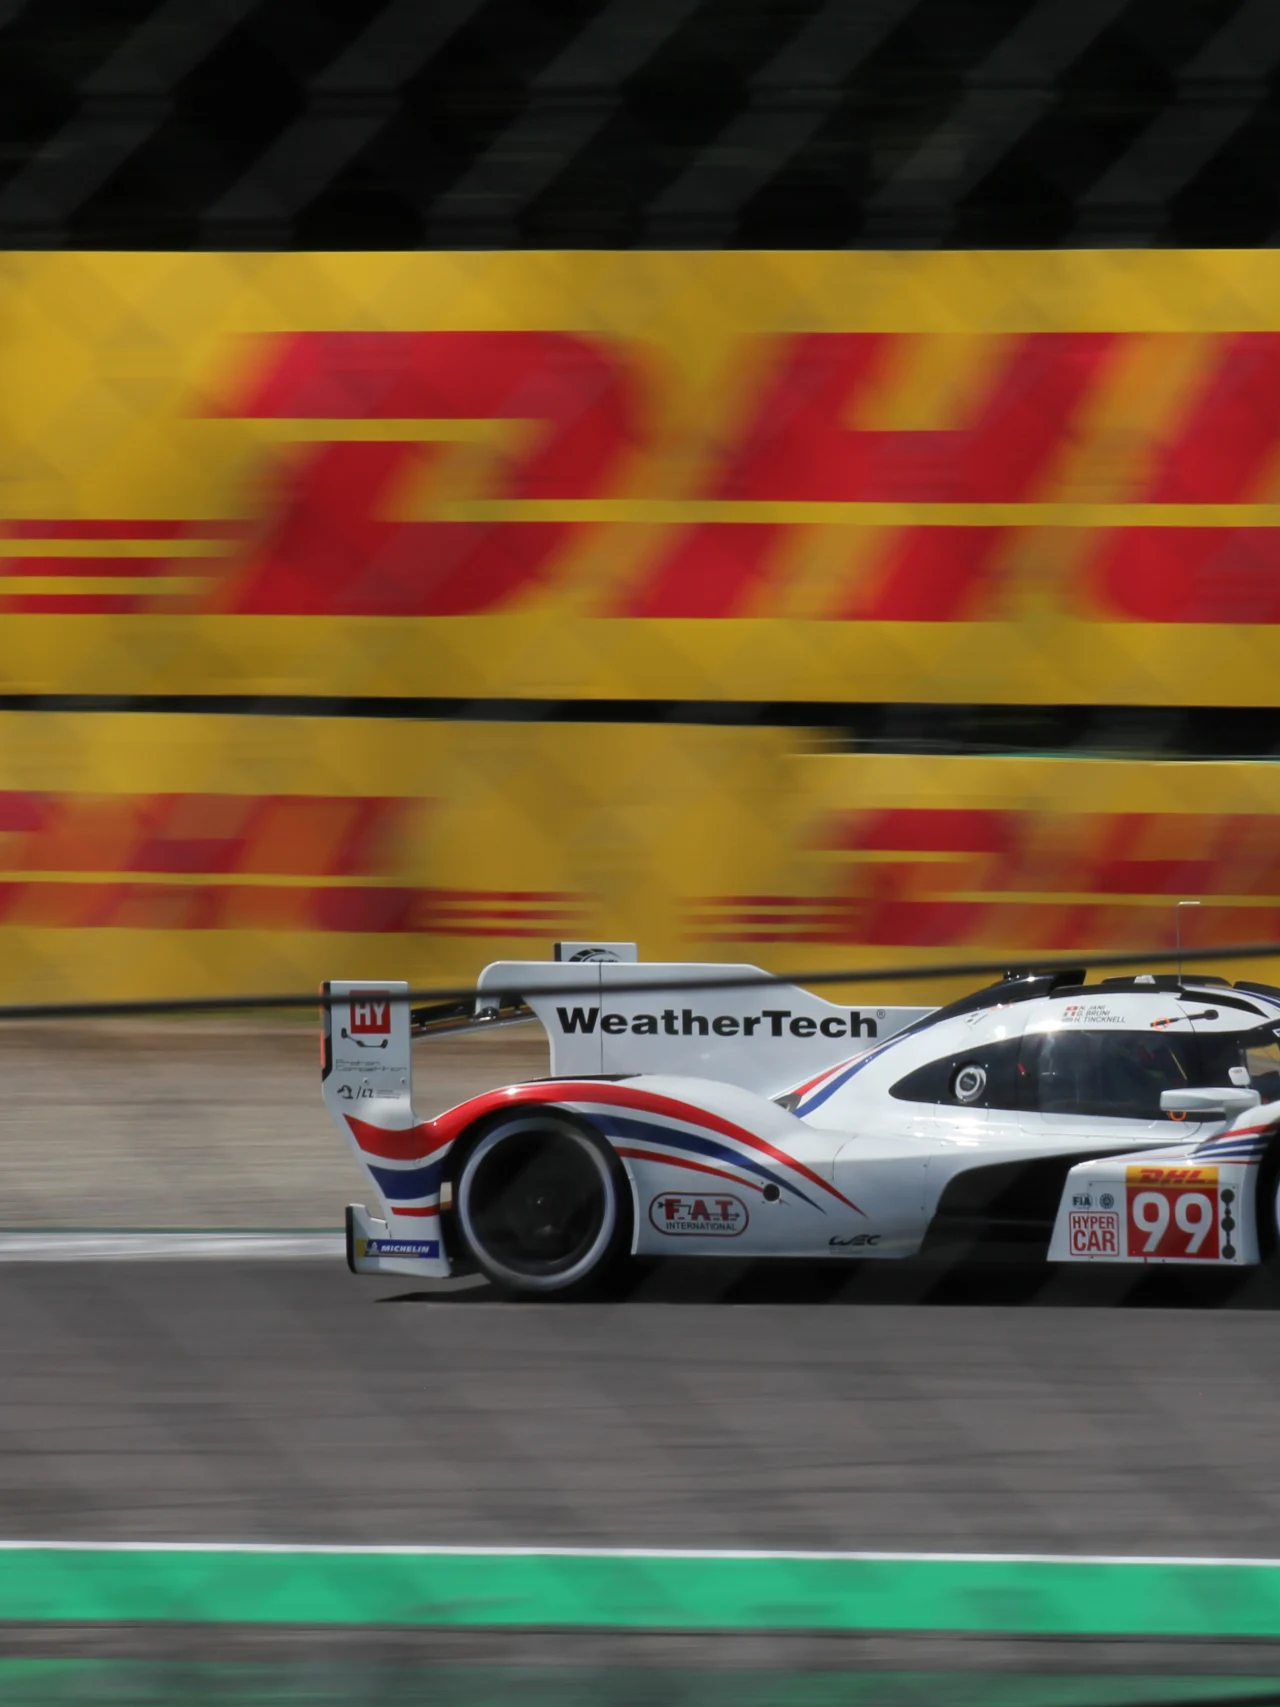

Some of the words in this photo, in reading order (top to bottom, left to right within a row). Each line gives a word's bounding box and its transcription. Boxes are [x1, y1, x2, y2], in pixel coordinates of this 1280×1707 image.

[354, 999, 386, 1026] HY
[1139, 1168, 1207, 1184] DHL
[1072, 1196, 1092, 1207] FIA
[665, 1221, 737, 1232] INTERNATIONAL
[1072, 1216, 1115, 1230] HYPER
[1132, 1191, 1213, 1254] 99
[828, 1234, 882, 1246] WEC
[1073, 1229, 1116, 1252] CAR
[380, 1244, 430, 1254] MICHELIN
